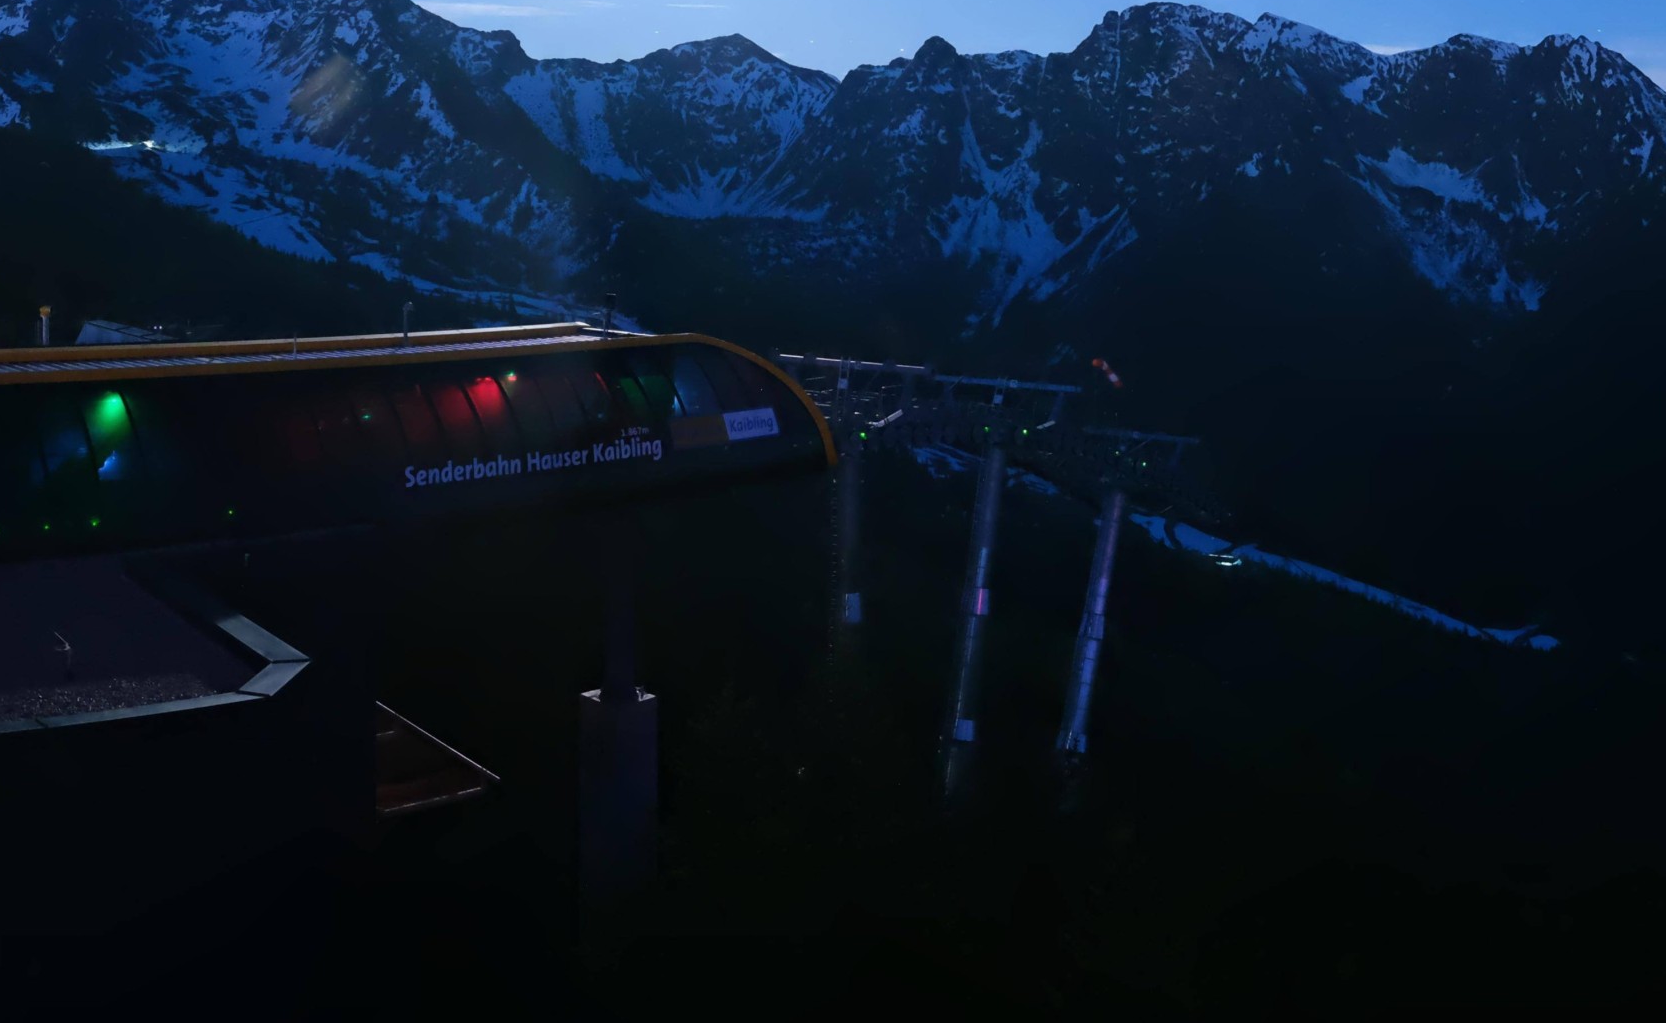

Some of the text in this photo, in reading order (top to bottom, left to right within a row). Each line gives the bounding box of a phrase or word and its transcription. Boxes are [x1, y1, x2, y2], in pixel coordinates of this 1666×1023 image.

[404, 436, 663, 488] Senderbahn Hauser Kaibling
